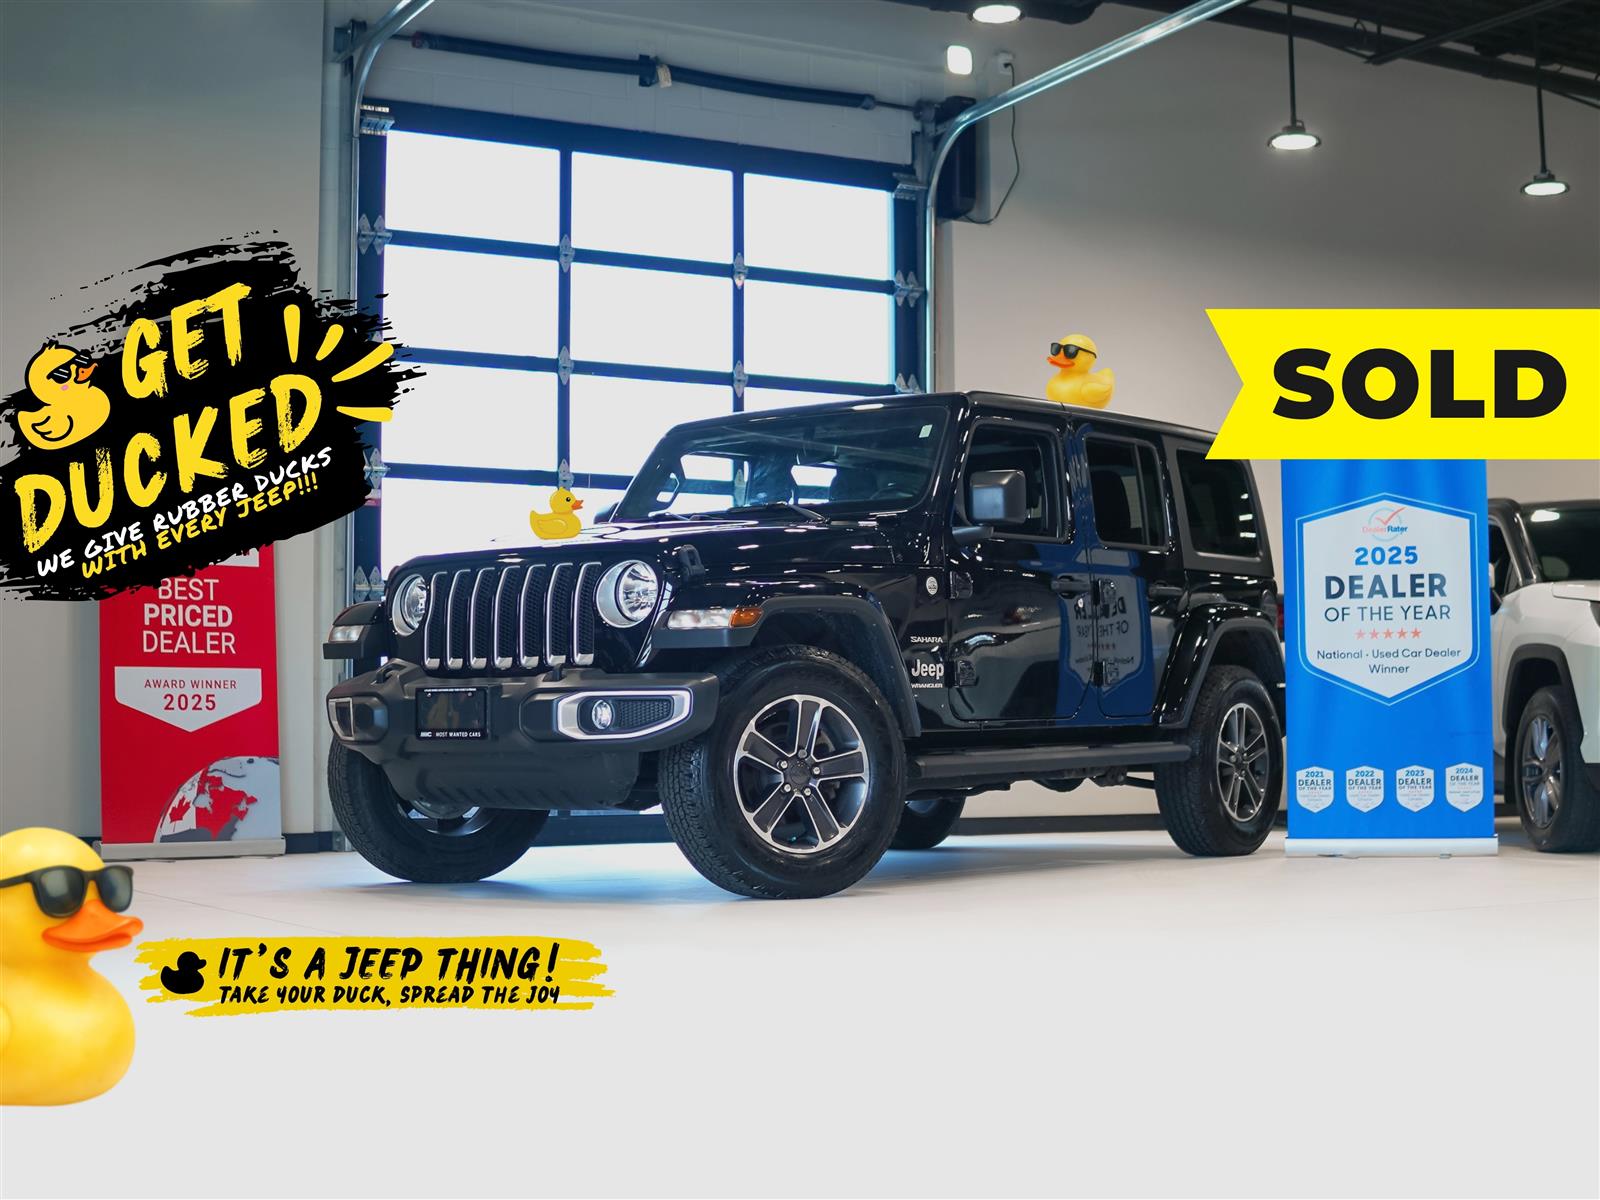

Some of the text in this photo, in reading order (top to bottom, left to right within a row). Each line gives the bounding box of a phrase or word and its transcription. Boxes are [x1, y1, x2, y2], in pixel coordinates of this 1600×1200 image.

[1354, 545, 1418, 566] 2025
[158, 578, 219, 601] BEST
[1325, 573, 1447, 600] DEALER
[143, 603, 233, 628] PRICED
[1324, 604, 1451, 623] OF THE YEAR
[142, 630, 236, 654] DEALER
[1317, 647, 1461, 660] National Used Car Dealer
[911, 659, 944, 680] Jeep
[1368, 663, 1409, 674] Winner
[144, 679, 237, 690] AWARD WINNER
[163, 694, 216, 711] 2025
